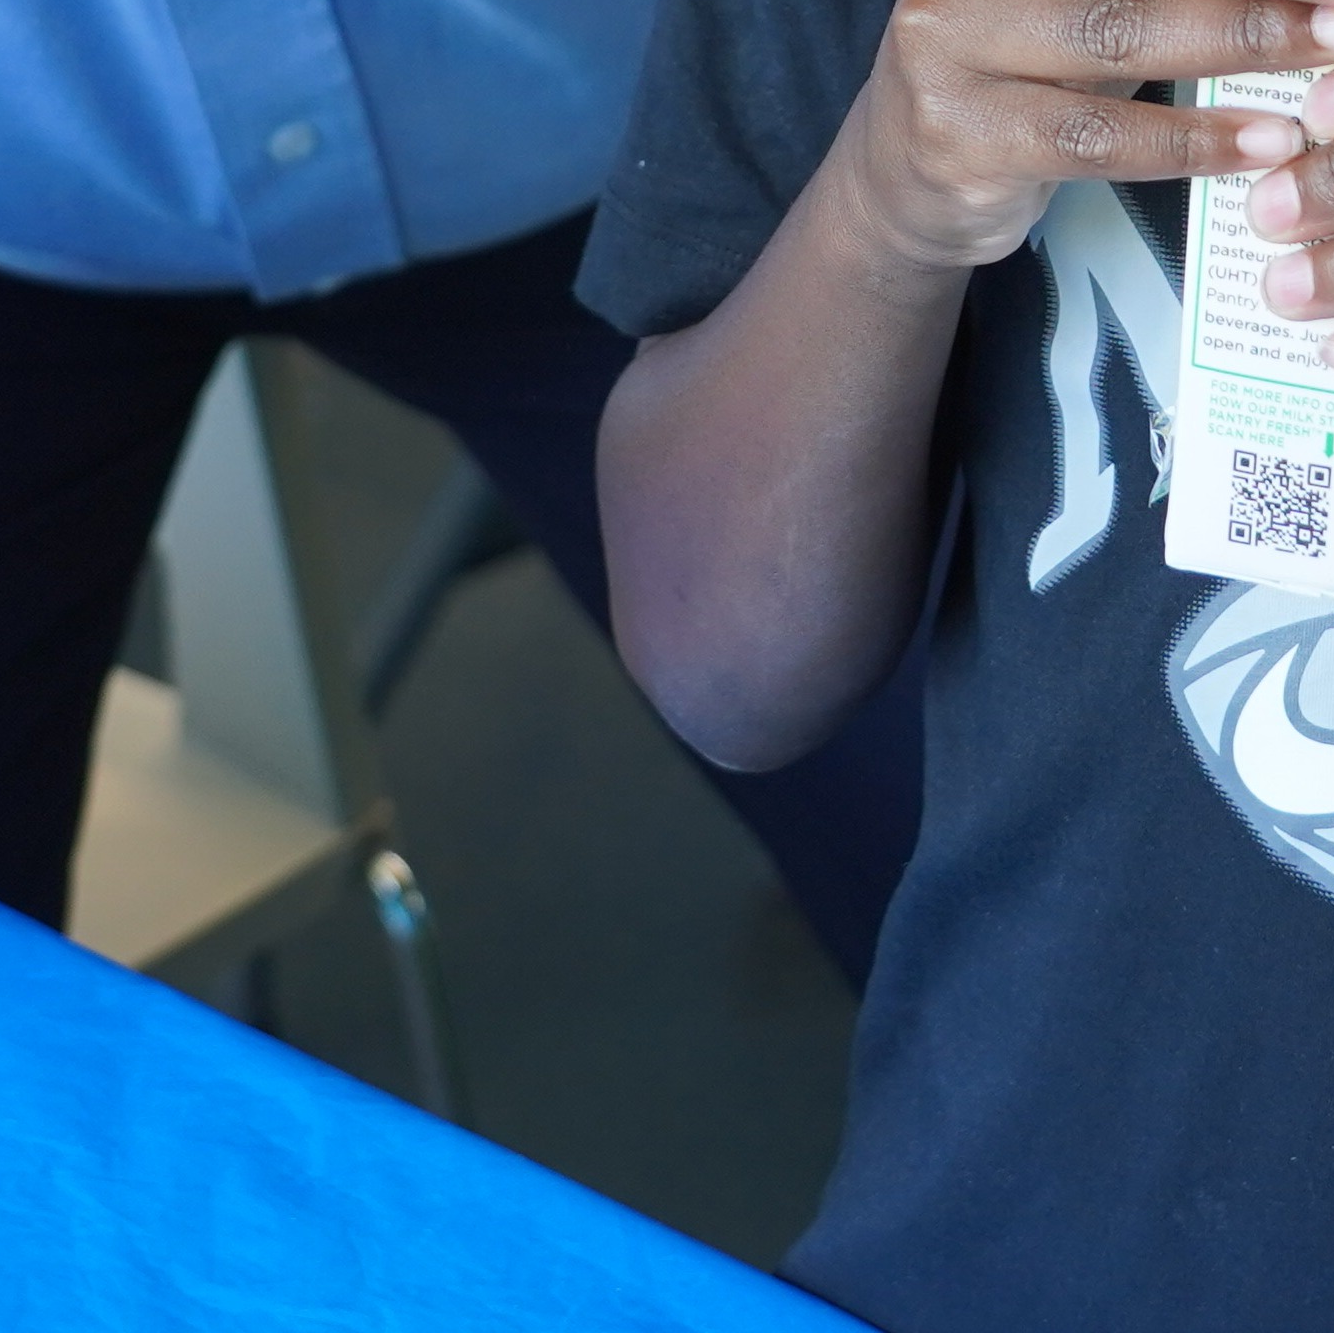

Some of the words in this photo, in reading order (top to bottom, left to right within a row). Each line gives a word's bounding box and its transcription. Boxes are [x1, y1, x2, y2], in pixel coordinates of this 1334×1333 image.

[1212, 217, 1249, 237] high
[1208, 265, 1258, 287] (UHT)
[1207, 287, 1259, 311] Pantry
[1205, 309, 1294, 340] beverages.
[1203, 336, 1244, 353] open
[1250, 345, 1281, 360] and
[1211, 379, 1238, 393] FOR
[1243, 386, 1282, 403] MORE
[1287, 395, 1321, 409] INFO
[1209, 408, 1261, 428] PANTRY
[1210, 394, 1243, 409] HOW
[1248, 402, 1277, 415] OUR
[1282, 408, 1313, 423] MILK
[1208, 422, 1244, 439] SCAN
[1249, 432, 1285, 448] HERE
